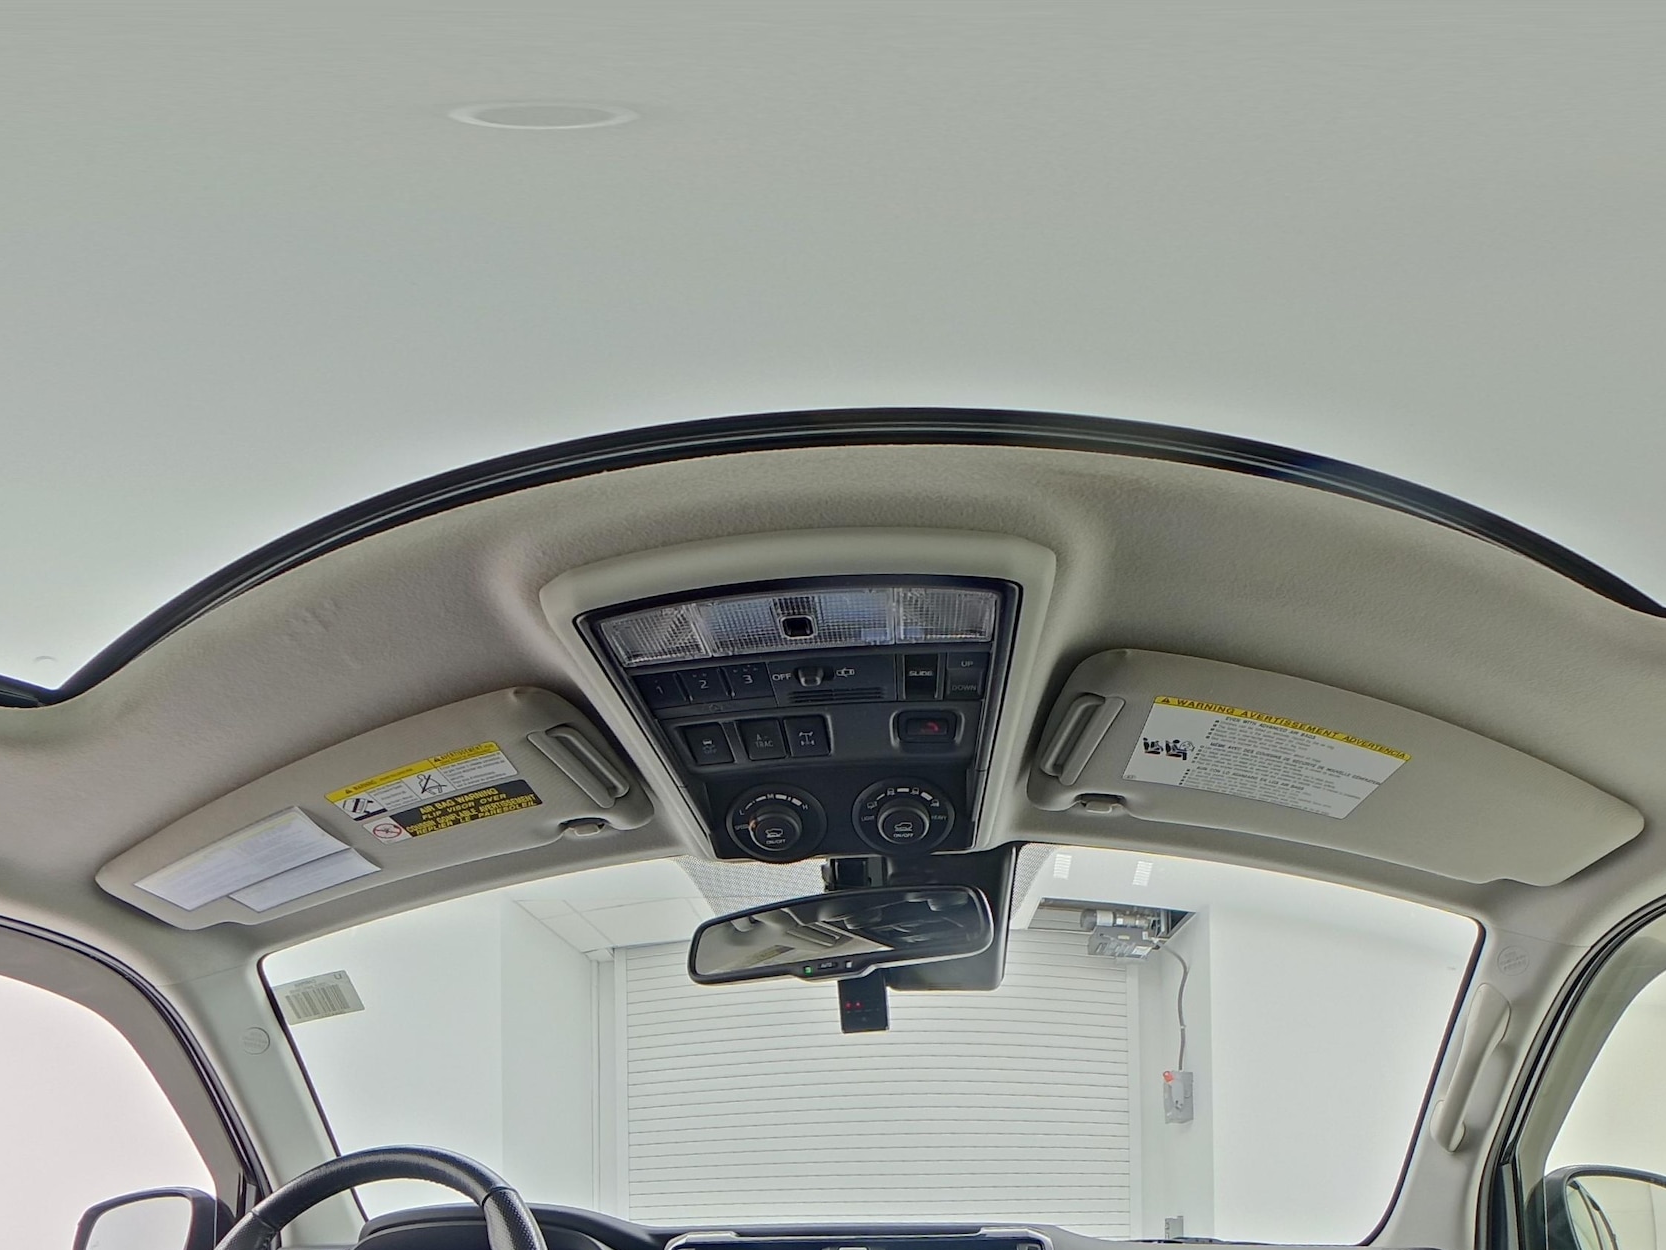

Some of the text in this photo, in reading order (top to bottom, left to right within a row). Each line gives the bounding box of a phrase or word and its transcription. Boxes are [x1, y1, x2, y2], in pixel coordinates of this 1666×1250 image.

[960, 660, 974, 668] UP
[742, 674, 754, 685] 3
[771, 672, 792, 682] OFF
[698, 679, 710, 689] 2
[951, 684, 977, 692] DOWN
[1177, 699, 1235, 714] WARNING
[1241, 709, 1337, 738] AVERTISSEMENT
[1343, 735, 1406, 758] ADVERTENCIA
[420, 787, 499, 815] AIR BAG WARNING
[422, 793, 507, 821] FLIP VISOR OVER
